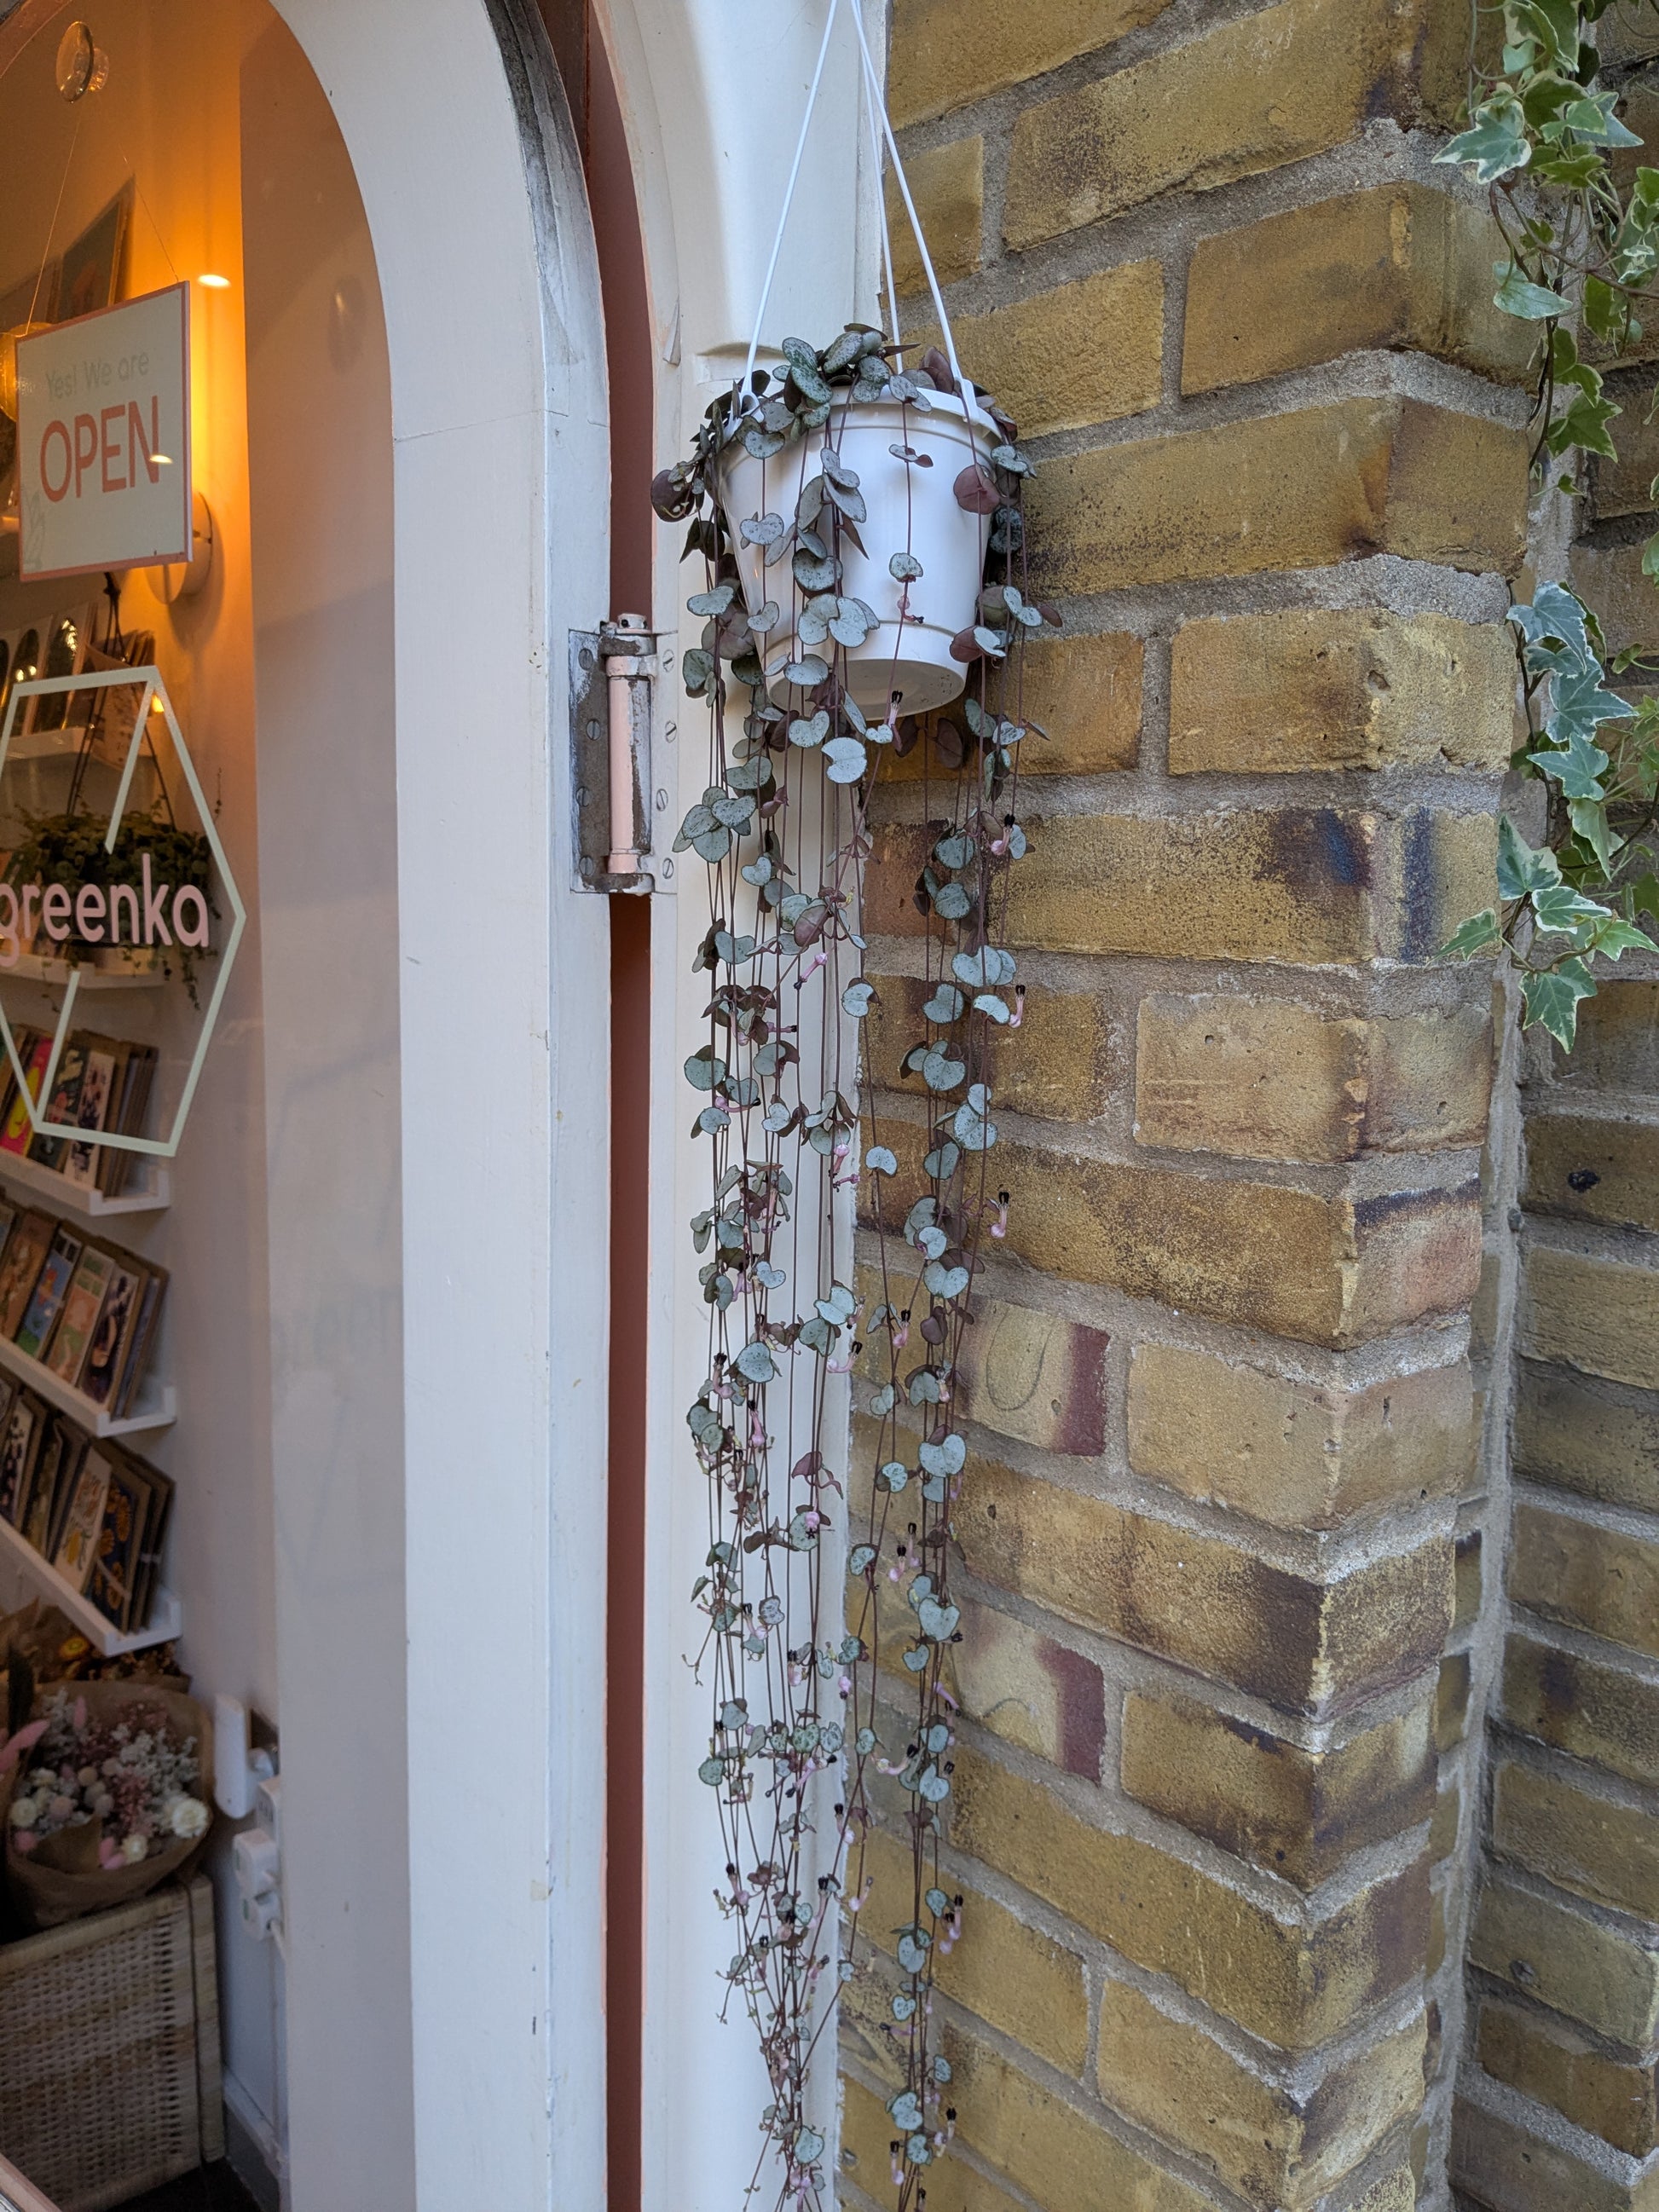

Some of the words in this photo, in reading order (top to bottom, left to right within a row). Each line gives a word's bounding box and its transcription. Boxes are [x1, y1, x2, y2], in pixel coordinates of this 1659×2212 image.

[45, 365, 77, 400] Yes!
[84, 360, 113, 391] We
[118, 351, 149, 380] are
[40, 396, 159, 502] OPEN
[0, 853, 209, 967] greenka
